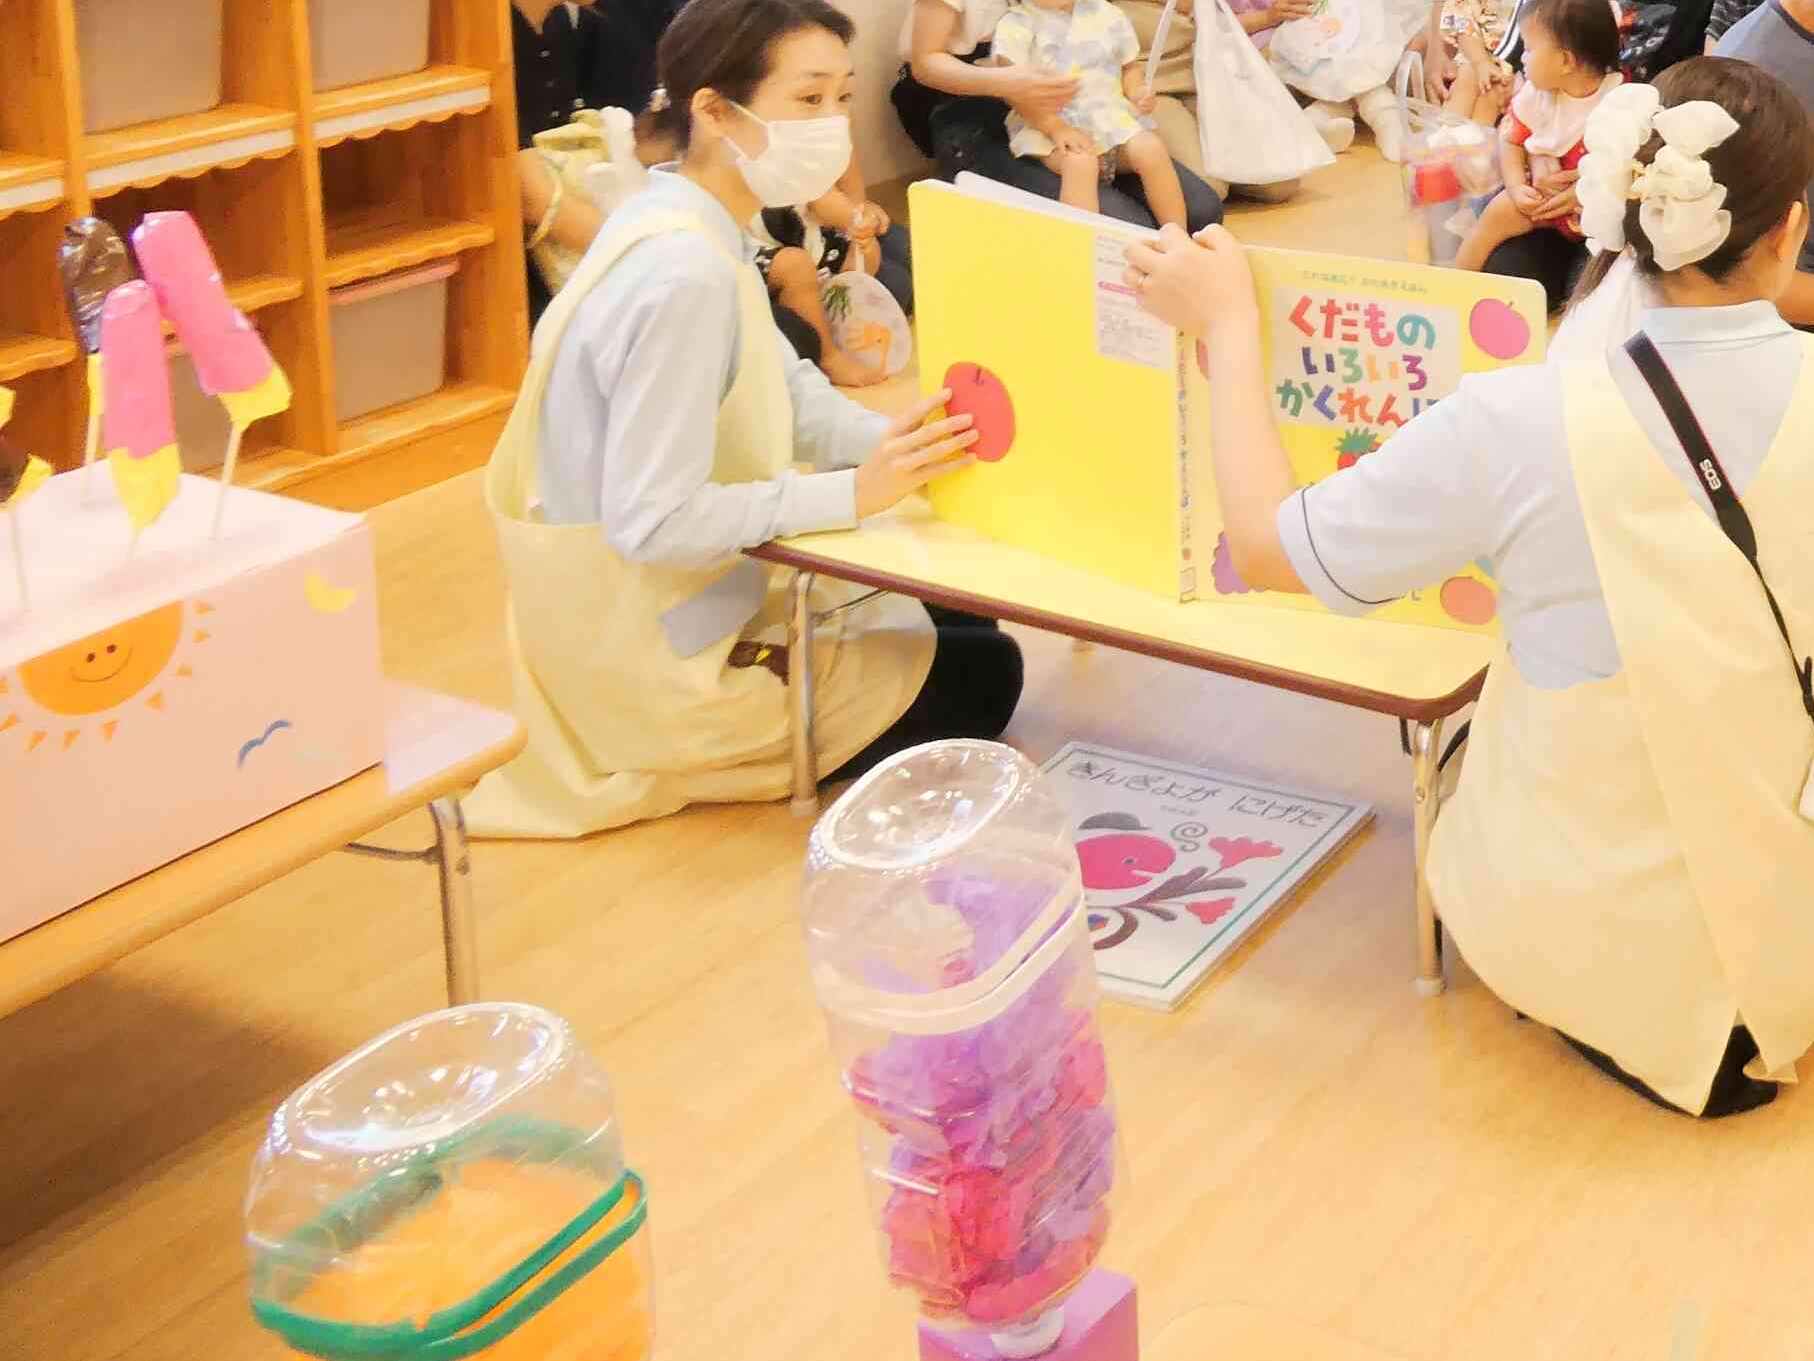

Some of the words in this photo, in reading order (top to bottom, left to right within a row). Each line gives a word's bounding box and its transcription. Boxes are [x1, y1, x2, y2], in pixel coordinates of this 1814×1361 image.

[1288, 294, 1437, 350] くだもの
[1301, 345, 1428, 391] いろいろ
[1699, 458, 1722, 490] EOS
[1228, 795, 1330, 828] にげた
